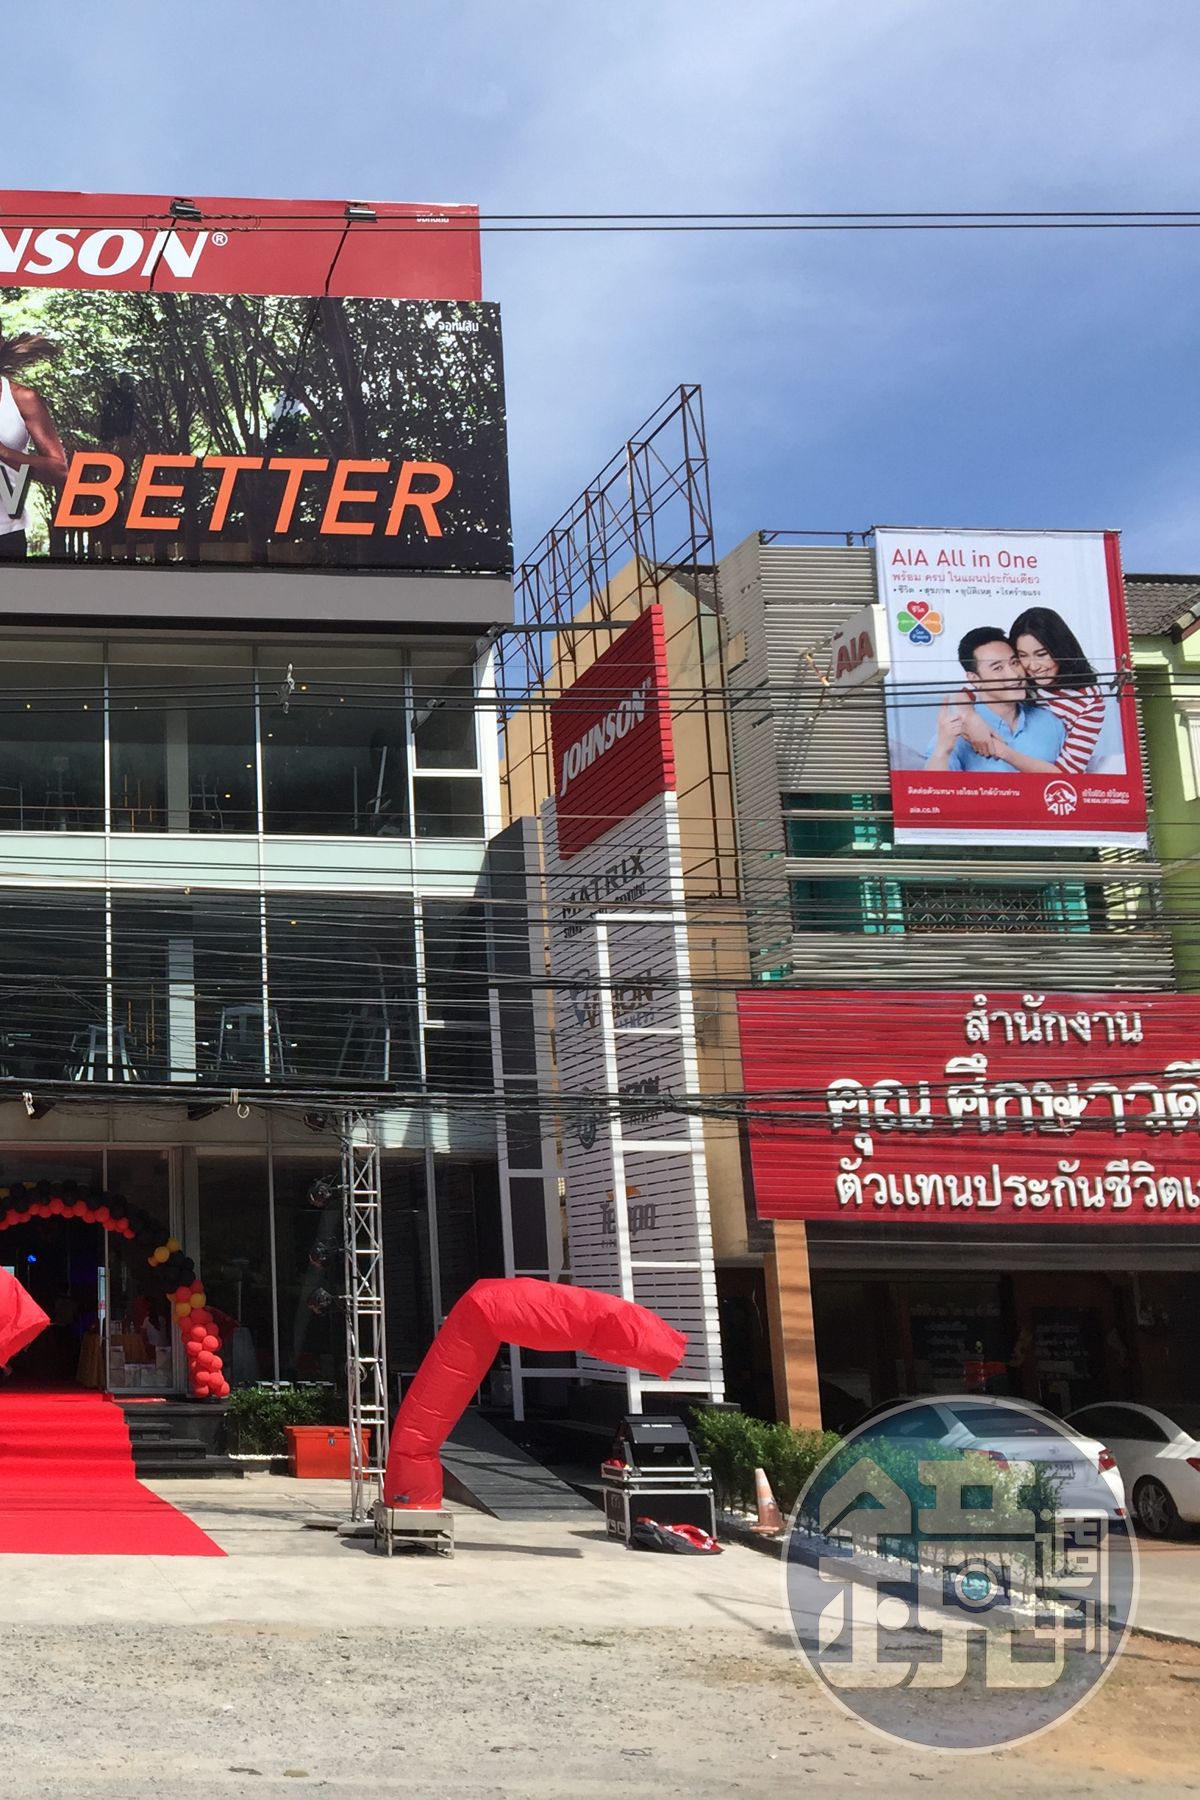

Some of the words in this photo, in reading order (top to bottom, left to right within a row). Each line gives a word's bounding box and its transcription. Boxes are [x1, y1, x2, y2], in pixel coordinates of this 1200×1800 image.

[54, 451, 454, 537] BETTER
[892, 548, 929, 566] AIA
[937, 549, 966, 567] All
[972, 550, 990, 567] in
[998, 550, 1038, 568] One
[836, 631, 874, 679] AIA
[909, 806, 941, 814] aia.co.th
[1047, 802, 1076, 816] AIA
[965, 994, 1144, 1042] สำนักงาน
[827, 1078, 935, 1156] คุณ
[836, 1157, 1200, 1209] ตัวแทนประกันชีวิตเ
[600, 1202, 656, 1236] Tepo
